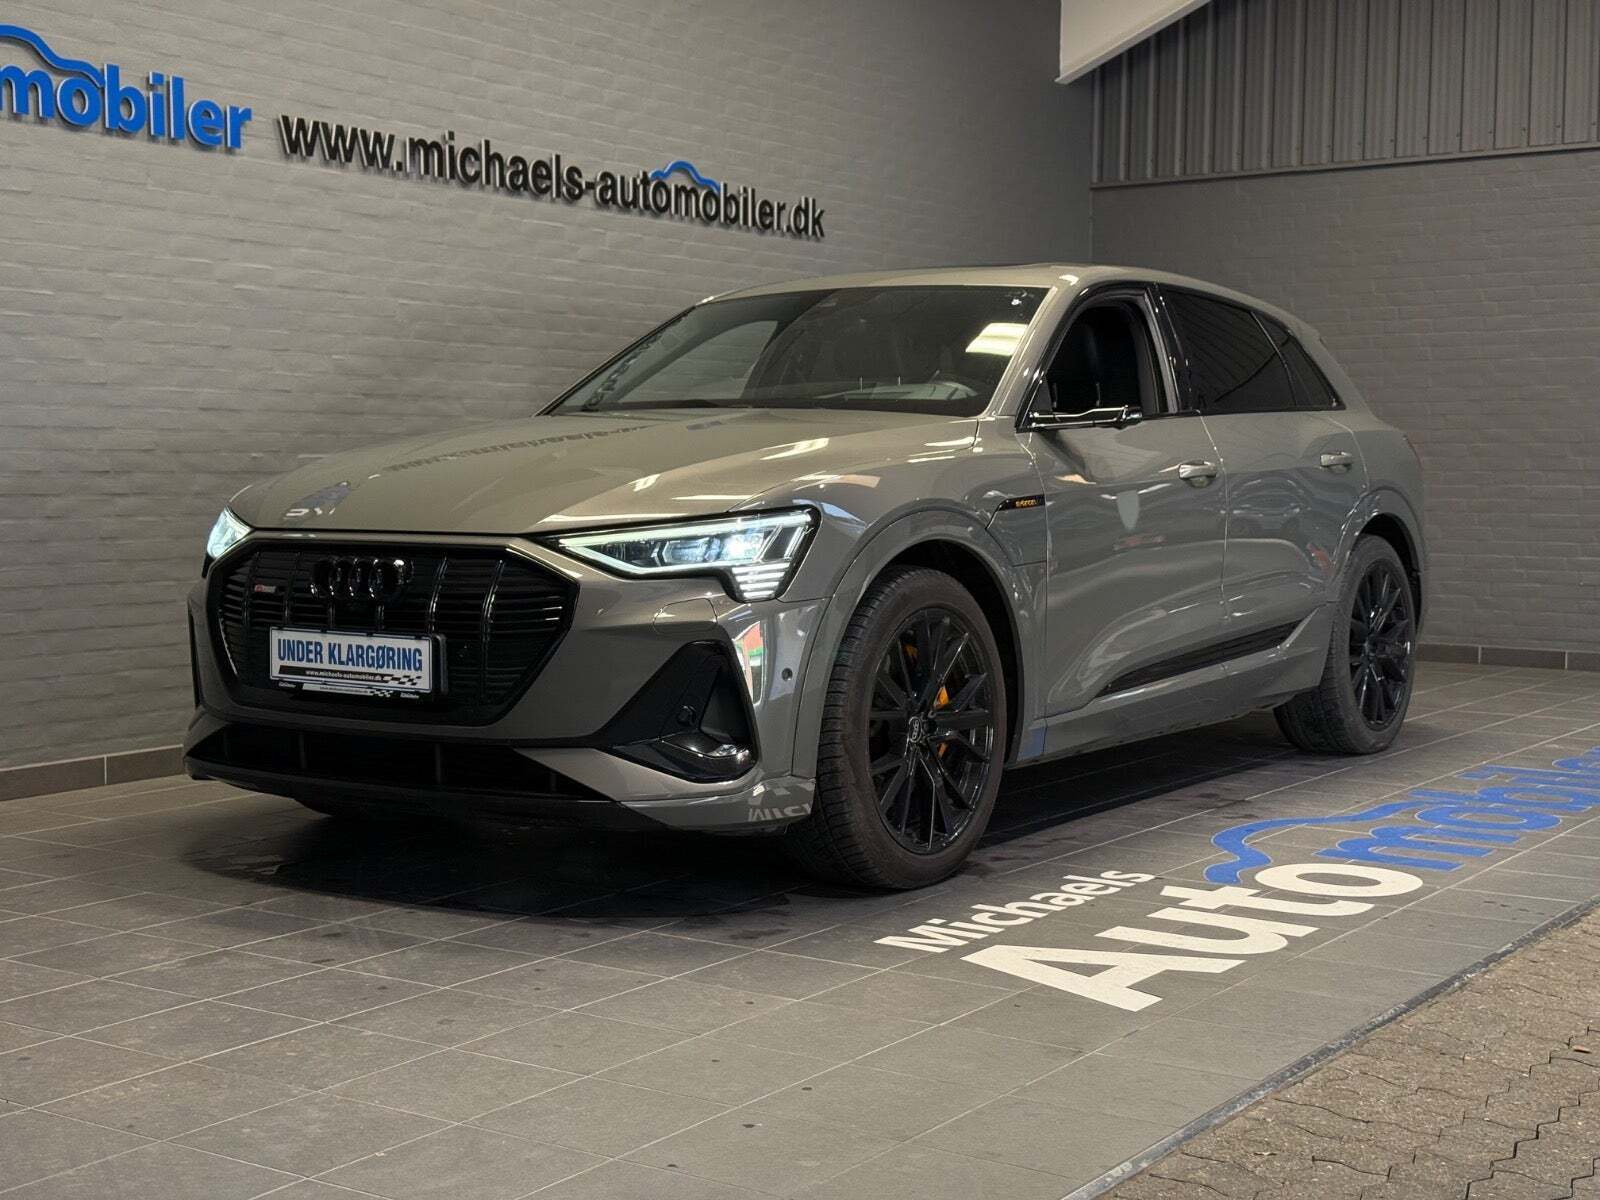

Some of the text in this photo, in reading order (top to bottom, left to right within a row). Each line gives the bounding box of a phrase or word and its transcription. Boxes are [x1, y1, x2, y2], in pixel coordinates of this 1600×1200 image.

[279, 114, 825, 238] www.michaels-automobiler.dk
[277, 638, 423, 672] UNDER KLARGØRING
[872, 870, 1156, 953] Michaels
